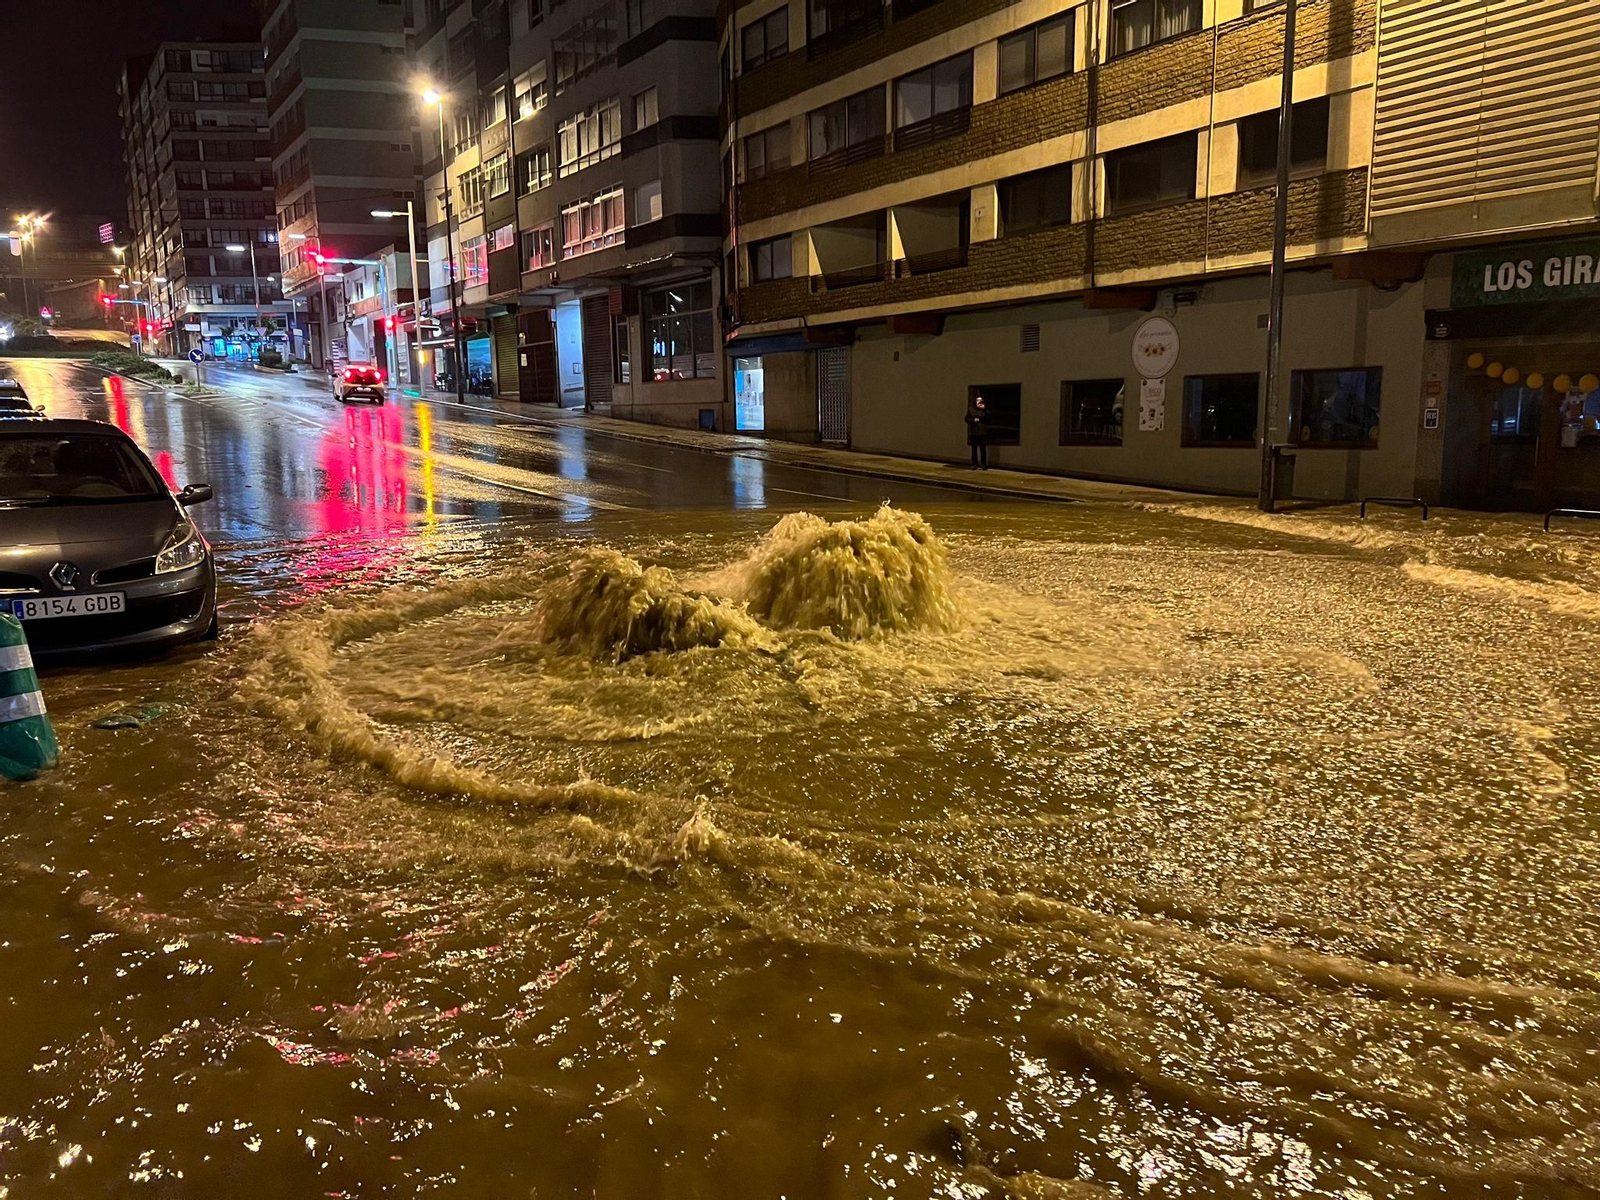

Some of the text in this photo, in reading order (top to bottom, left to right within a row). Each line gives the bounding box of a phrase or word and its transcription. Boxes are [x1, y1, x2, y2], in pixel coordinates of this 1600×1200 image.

[1483, 259, 1534, 292] LOS
[26, 596, 121, 616] 8154 GDB
